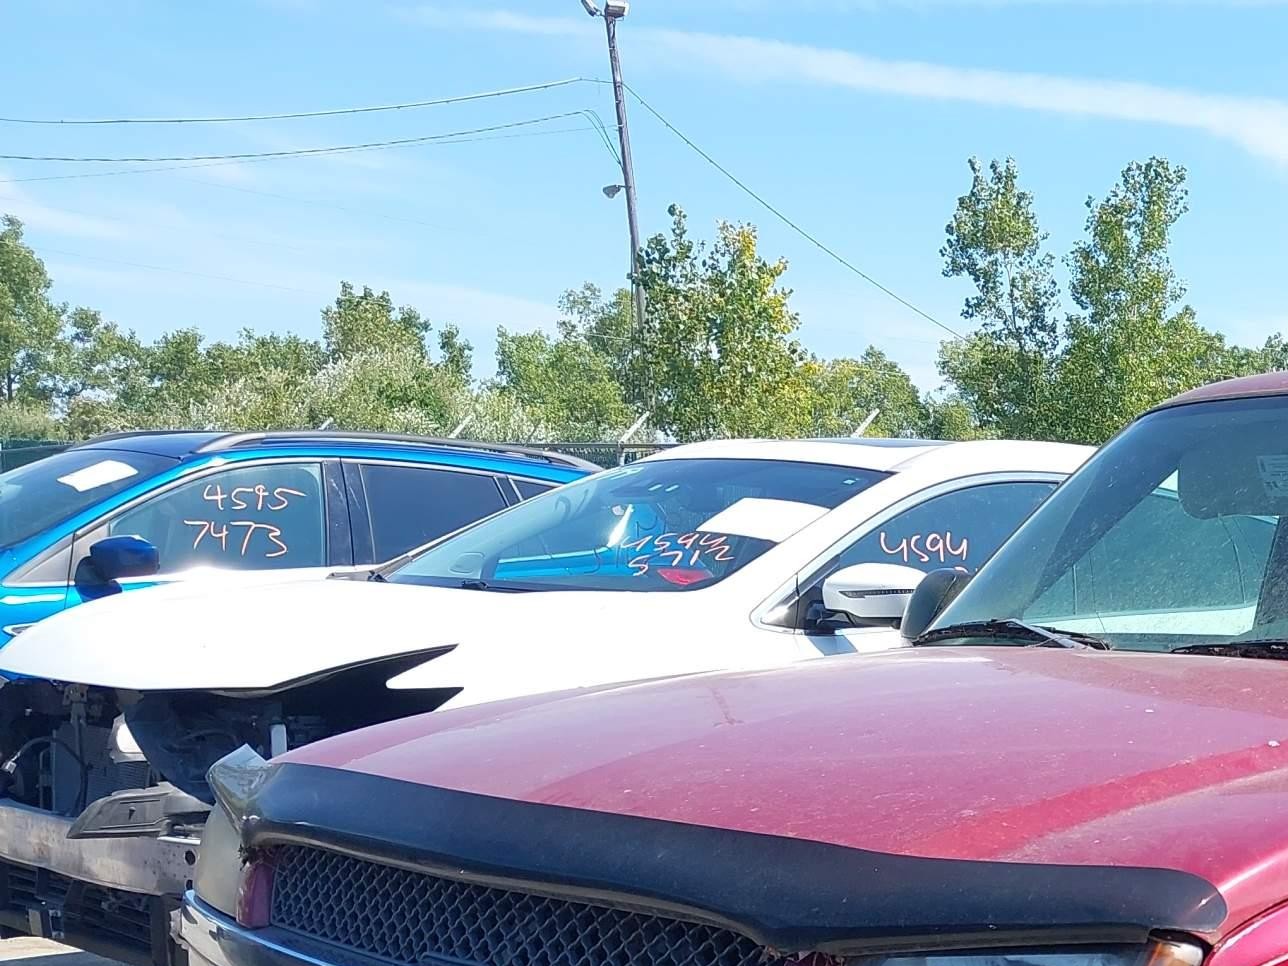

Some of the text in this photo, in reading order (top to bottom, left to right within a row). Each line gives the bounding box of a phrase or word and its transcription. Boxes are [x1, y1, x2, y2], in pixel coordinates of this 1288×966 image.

[203, 484, 307, 511] 4595
[183, 519, 288, 557] 7473
[620, 532, 728, 552] 4594
[880, 531, 968, 562] 4594
